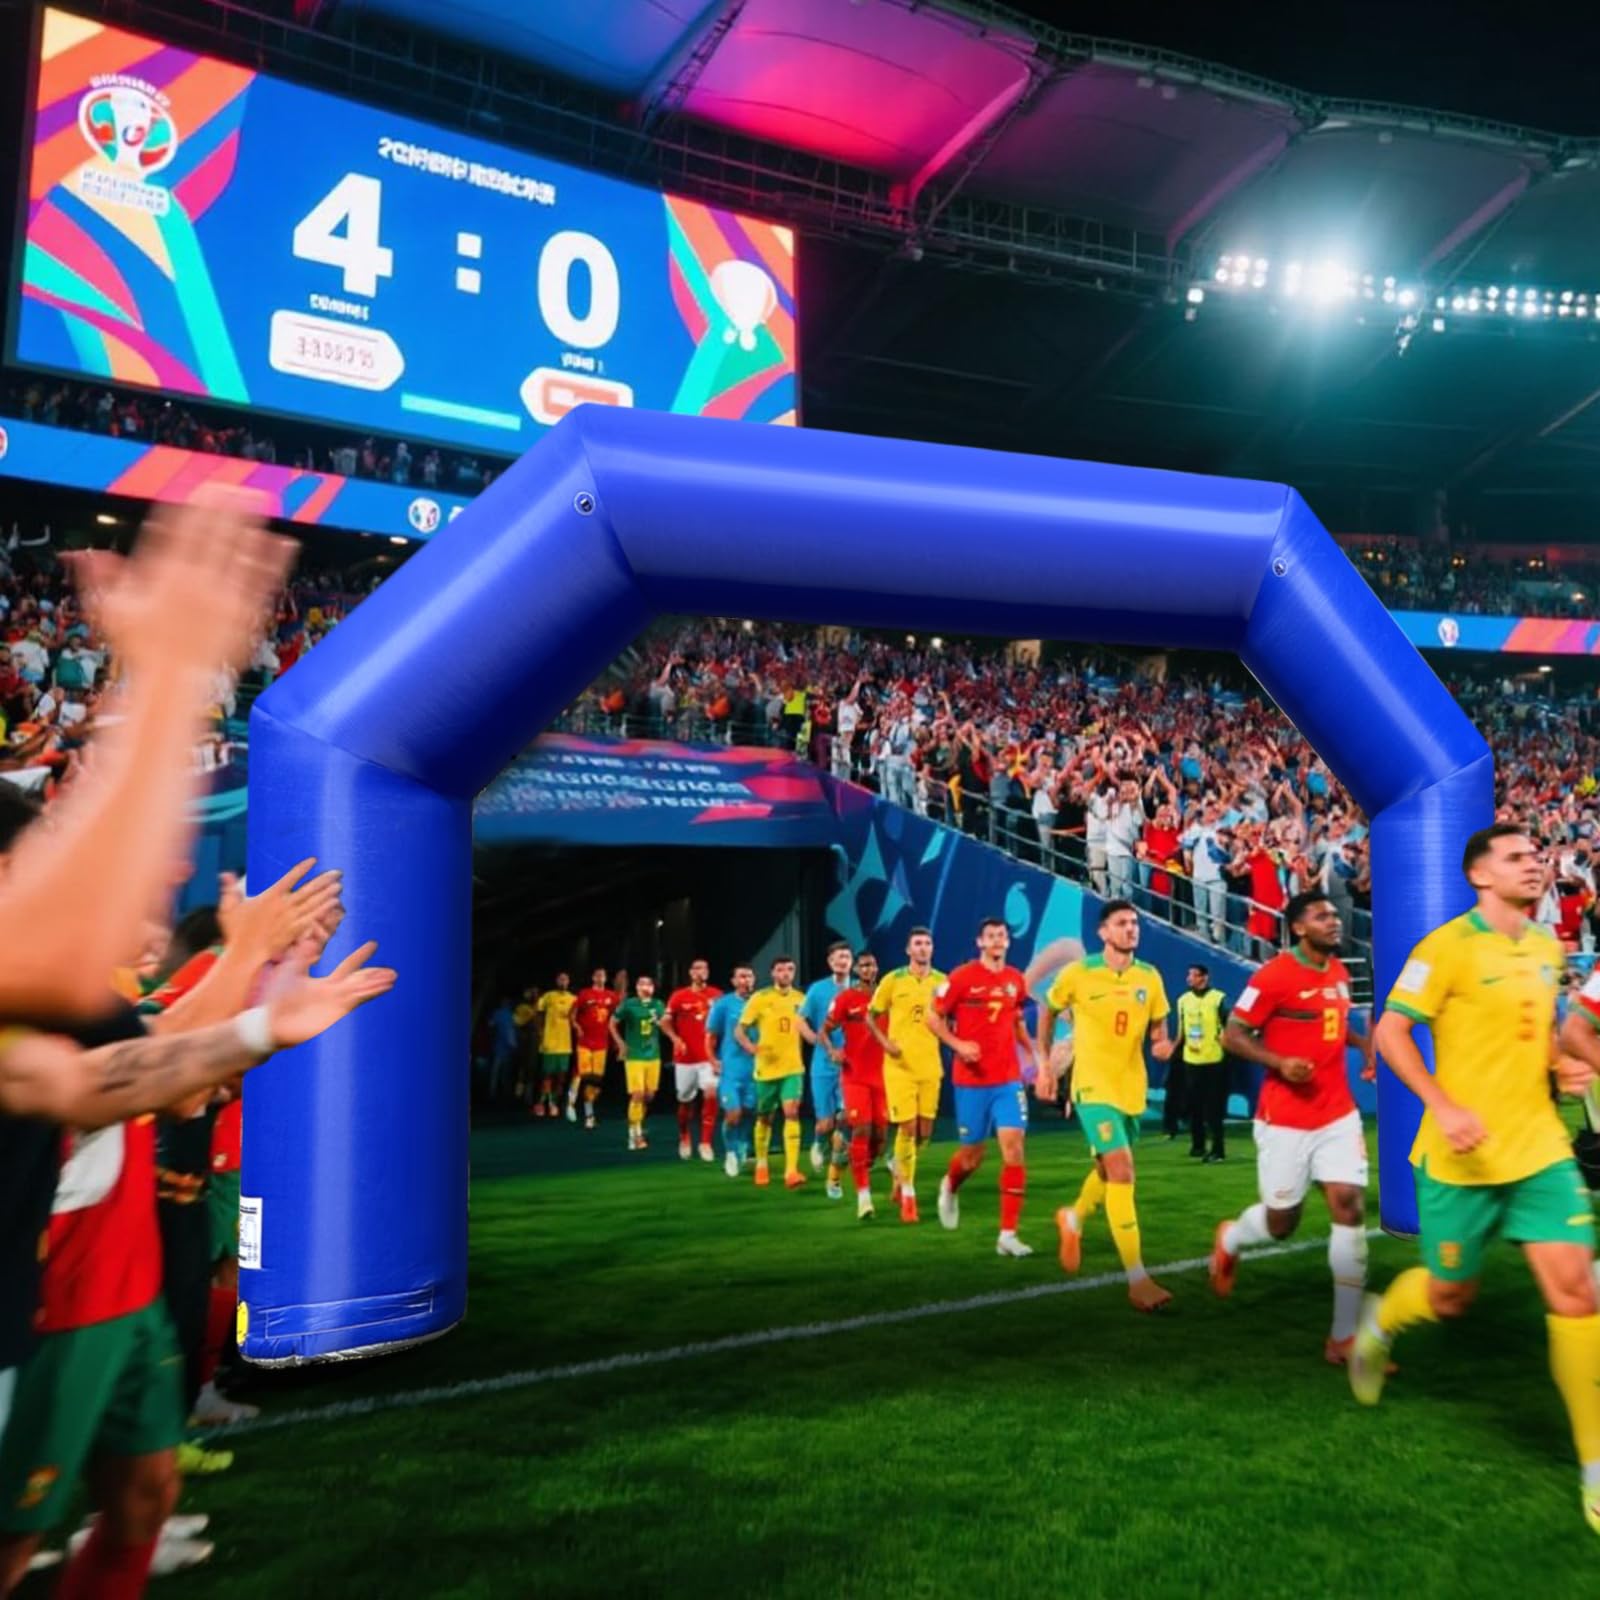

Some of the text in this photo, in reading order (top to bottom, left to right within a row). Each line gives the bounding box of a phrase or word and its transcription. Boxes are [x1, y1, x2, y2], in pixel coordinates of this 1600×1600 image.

[293, 173, 393, 298] 4
[537, 231, 620, 349] 0
[987, 1001, 1003, 1024] 7
[1115, 1010, 1129, 1037] 8
